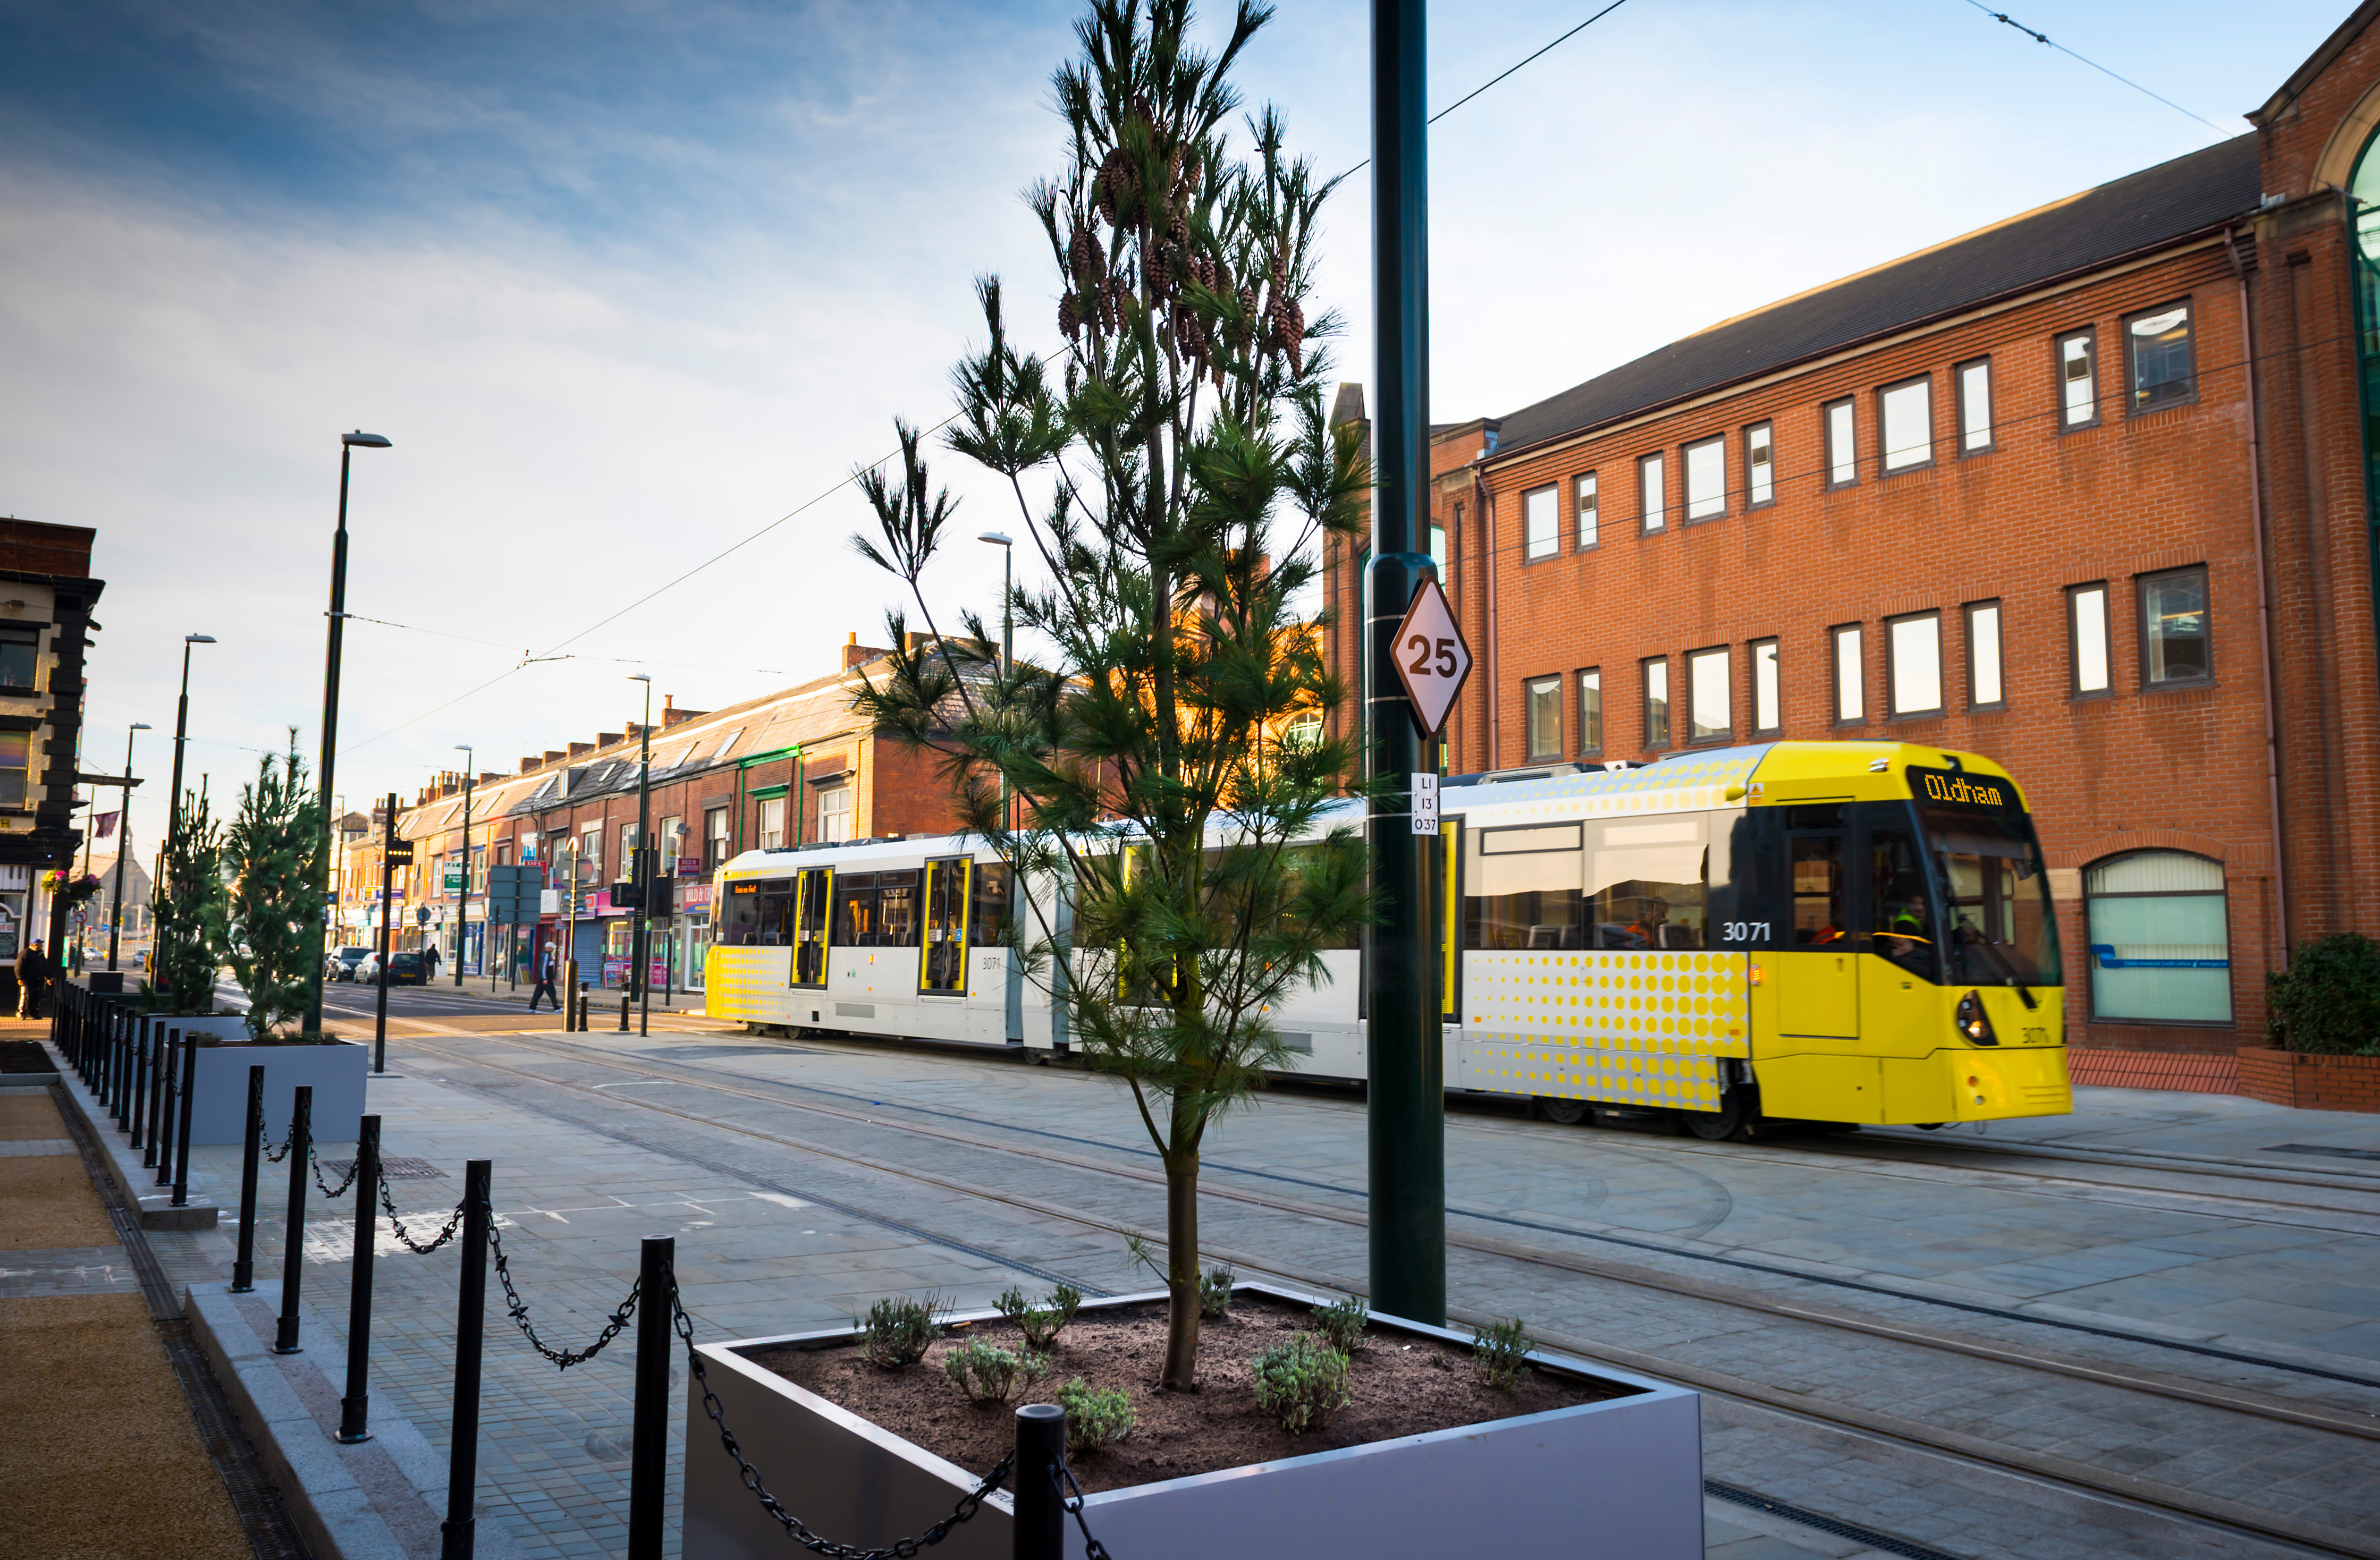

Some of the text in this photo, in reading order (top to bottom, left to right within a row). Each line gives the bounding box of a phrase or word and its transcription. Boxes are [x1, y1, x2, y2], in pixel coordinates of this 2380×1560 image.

[1408, 634, 1457, 678] 25
[1925, 774, 2003, 806] Oldham
[686, 888, 698, 902] WILD
[698, 888, 704, 901] &
[1723, 922, 1770, 941] 3071
[983, 957, 1000, 970] 3071
